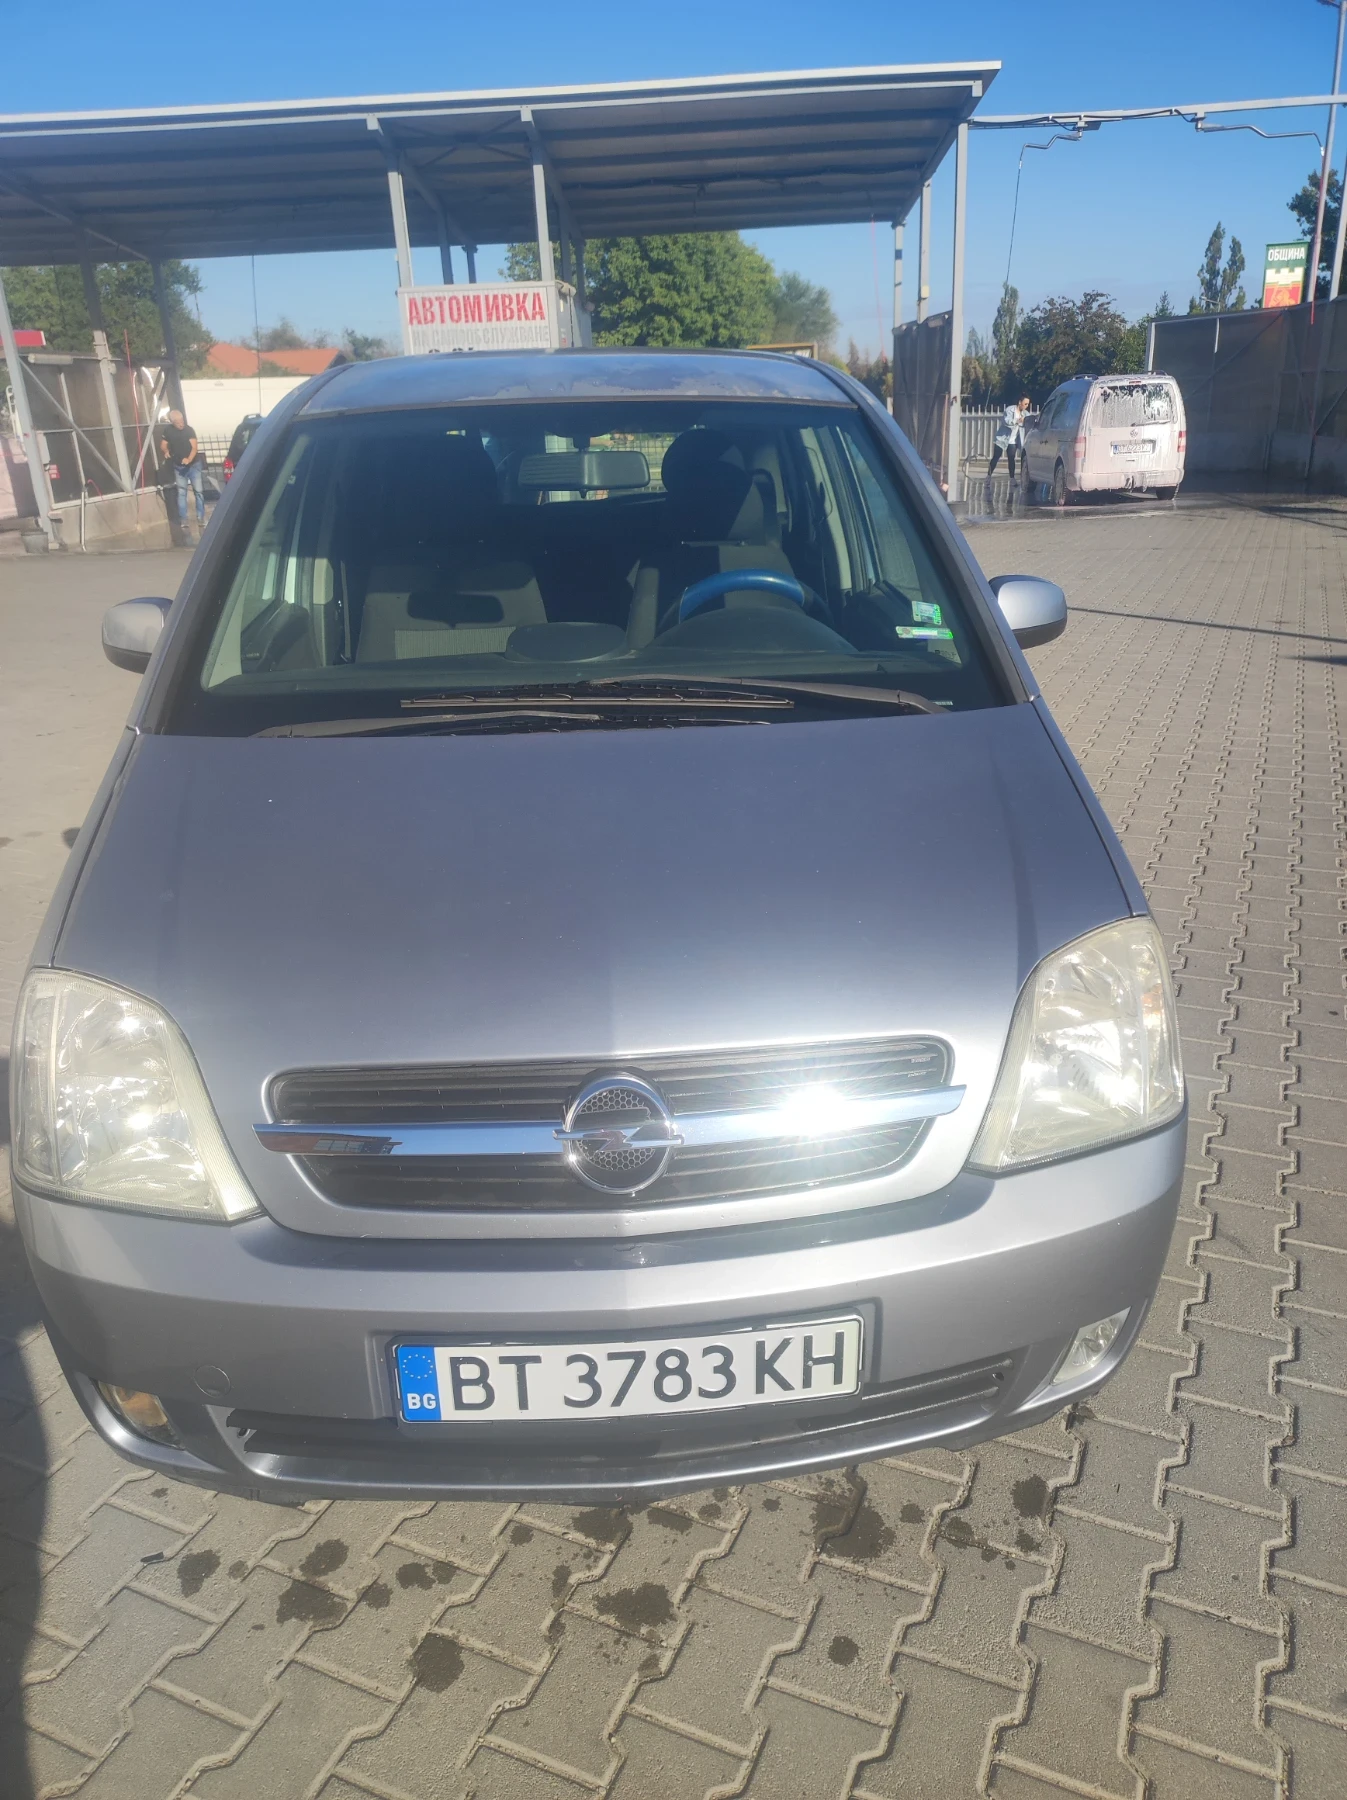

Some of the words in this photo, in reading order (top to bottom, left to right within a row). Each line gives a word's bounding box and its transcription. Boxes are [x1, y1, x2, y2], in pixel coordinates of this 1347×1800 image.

[1268, 247, 1305, 261] ОБЩИНА
[408, 292, 545, 326] АВТОМИВКА
[449, 1356, 542, 1412] BT
[563, 1345, 737, 1408] 3783
[754, 1331, 845, 1395] KH
[407, 1393, 437, 1409] BG
